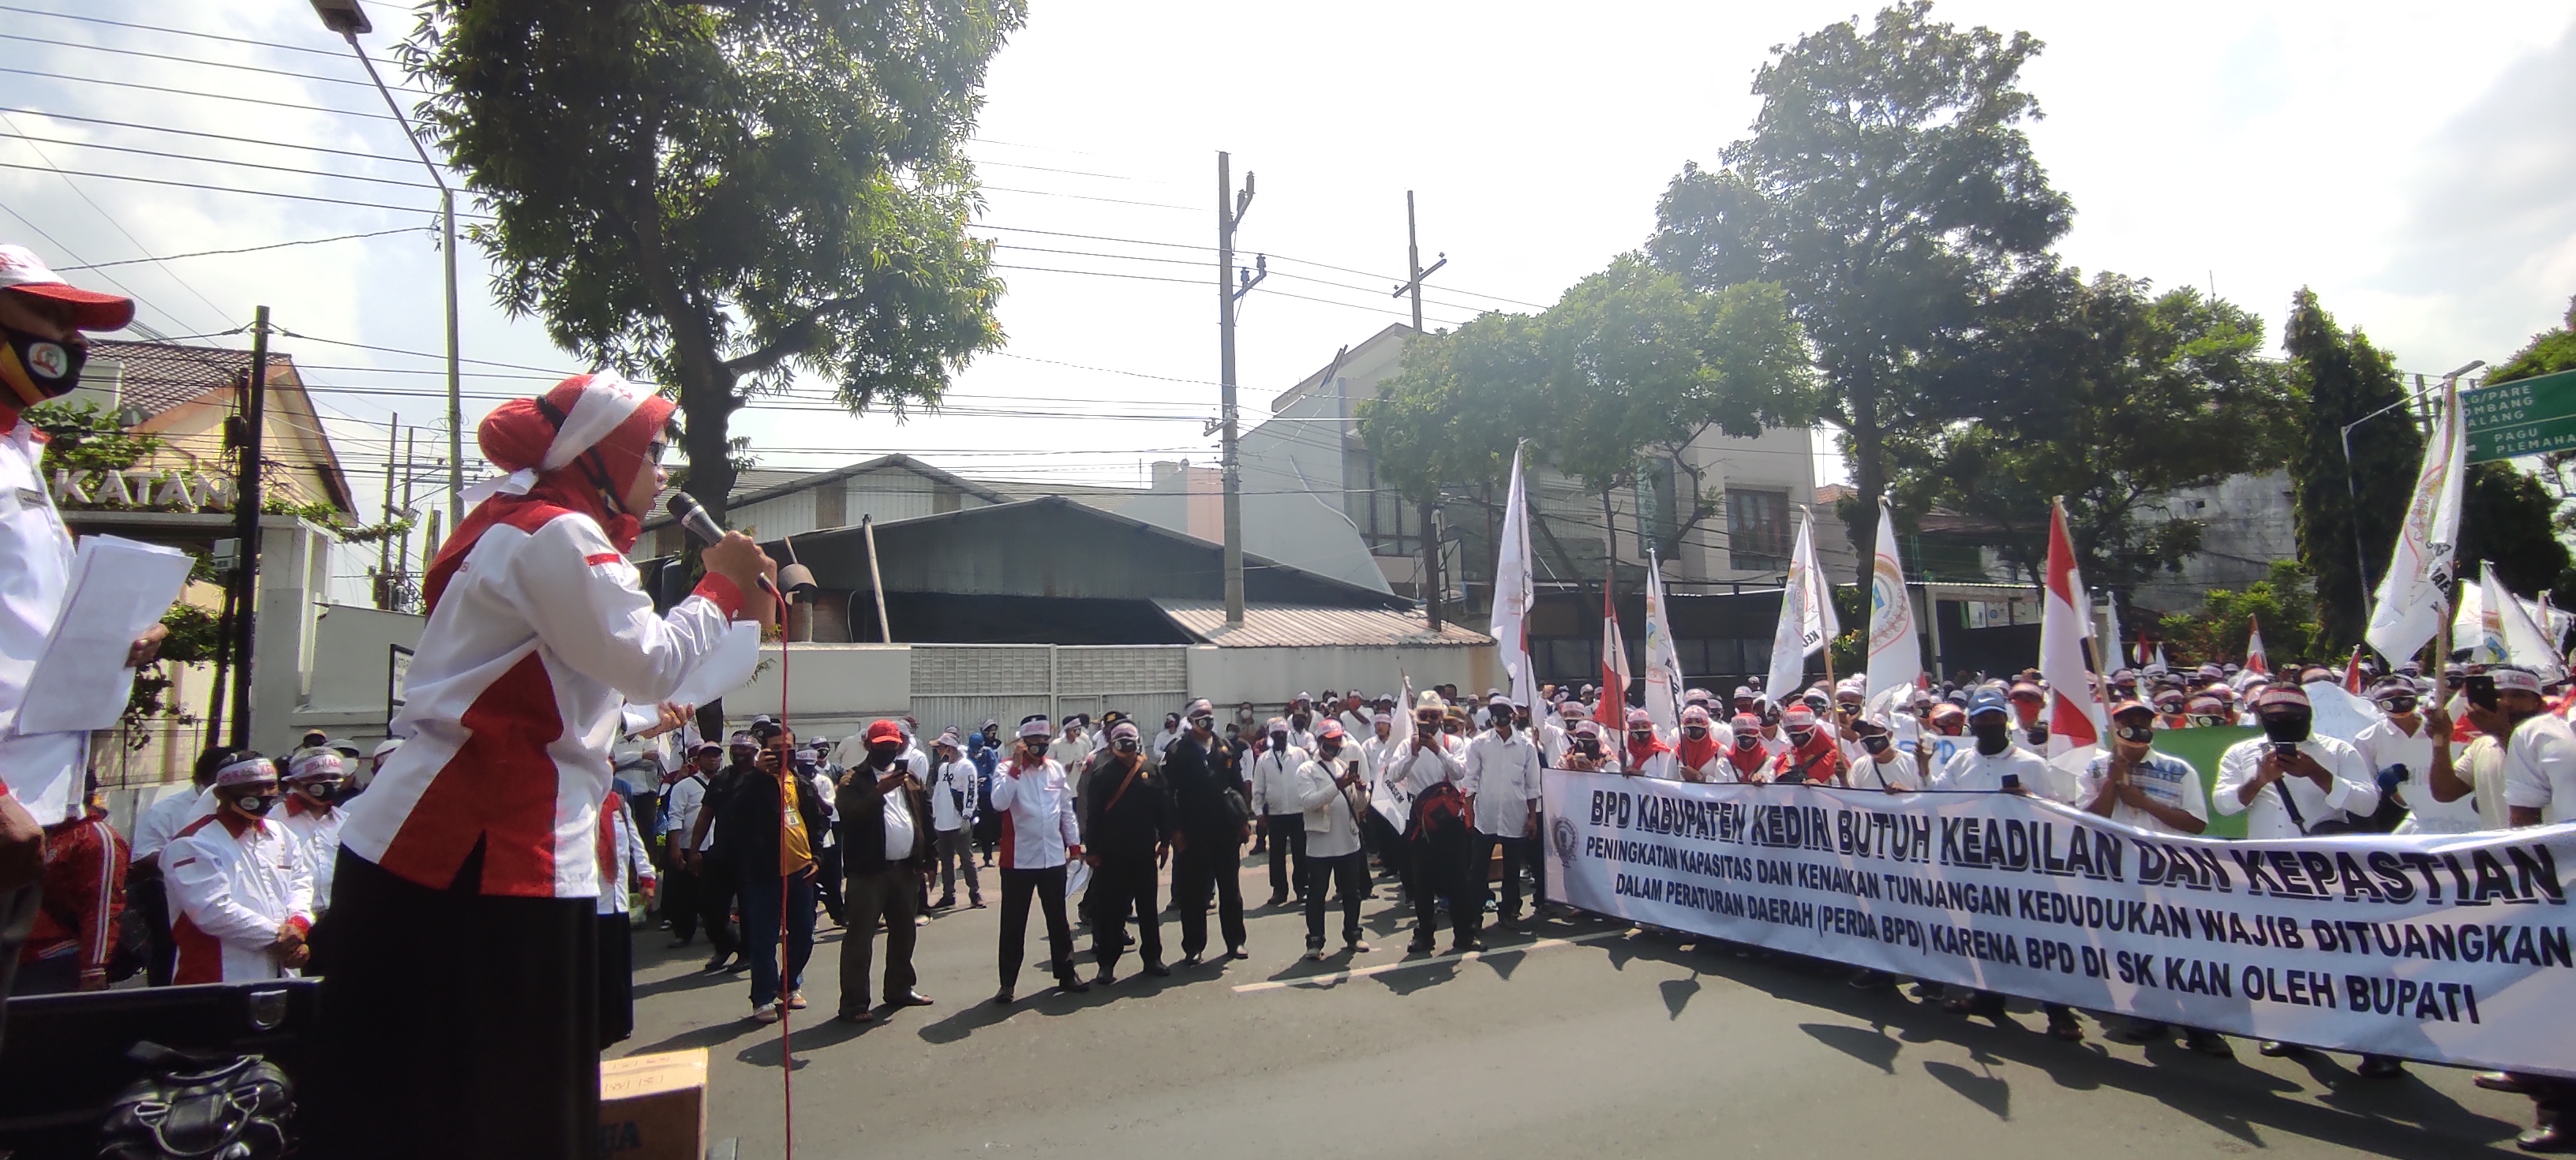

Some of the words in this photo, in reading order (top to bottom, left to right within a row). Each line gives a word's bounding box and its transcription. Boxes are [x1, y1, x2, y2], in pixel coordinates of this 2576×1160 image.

[2495, 428, 2537, 442] PAGU
[1586, 836, 1677, 870] PENINGKATAN
[1680, 849, 1752, 881] KAPASITAS
[1757, 859, 1792, 886] DAN
[1798, 863, 1880, 900] KENAIKAN
[1884, 874, 2012, 917] TUNJANGAN
[2018, 889, 2192, 939] KEDUDUKAN
[2196, 908, 2304, 949] WAJIB
[2311, 919, 2573, 968] DITUANGKAN
[1589, 790, 1631, 828] BPD
[1636, 794, 1747, 844] KABUPATEN
[1751, 804, 1834, 851] KEDIRI
[1837, 810, 1930, 863] BUTUH
[1940, 816, 2124, 882] KEADILAN
[2129, 838, 2233, 892] DAN
[2229, 844, 2567, 906] KEPASTIAN
[1616, 873, 1662, 901] DALAM
[1666, 881, 1745, 917] PERATURAN
[1747, 894, 1813, 928] DAERAH
[1818, 904, 1879, 940] (PERDA
[1881, 915, 1926, 956] BPD)
[1930, 922, 2021, 966] KARENA
[2025, 937, 2075, 974] BPD
[2081, 945, 2110, 980] DI
[2117, 950, 2159, 987] SK
[2165, 956, 2232, 997] KAN
[2241, 965, 2336, 1009] OLEH
[2345, 975, 2481, 1024] BUPATI
